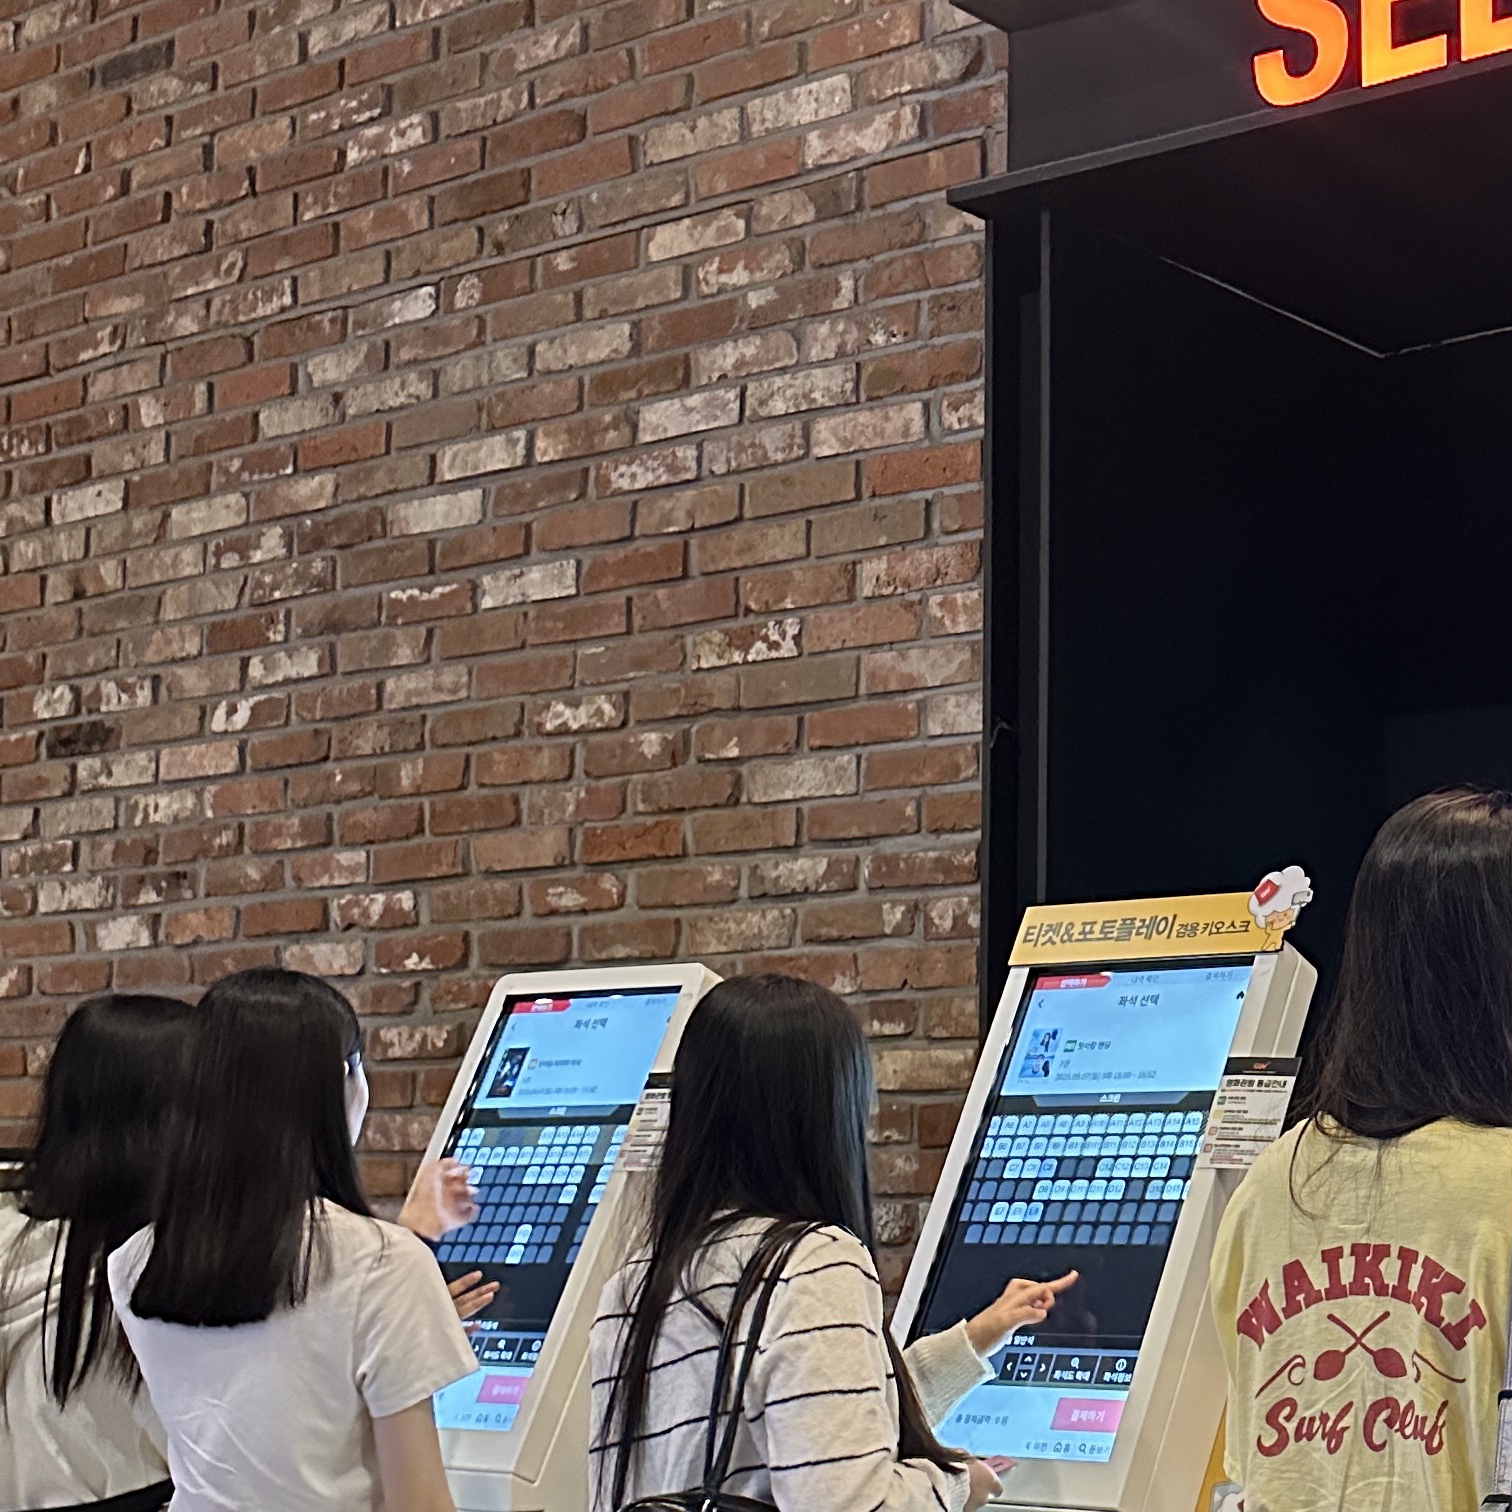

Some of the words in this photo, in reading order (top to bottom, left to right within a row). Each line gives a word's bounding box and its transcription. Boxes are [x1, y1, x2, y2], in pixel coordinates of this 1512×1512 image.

[1022, 913, 1178, 947] 티켓&포토플레이
[1175, 923, 1200, 938] 겸용
[1200, 919, 1250, 935] 키오스크
[1236, 1242, 1487, 1351] WAIKIKI
[1256, 1396, 1354, 1457] Surf
[1363, 1396, 1449, 1456] Club
